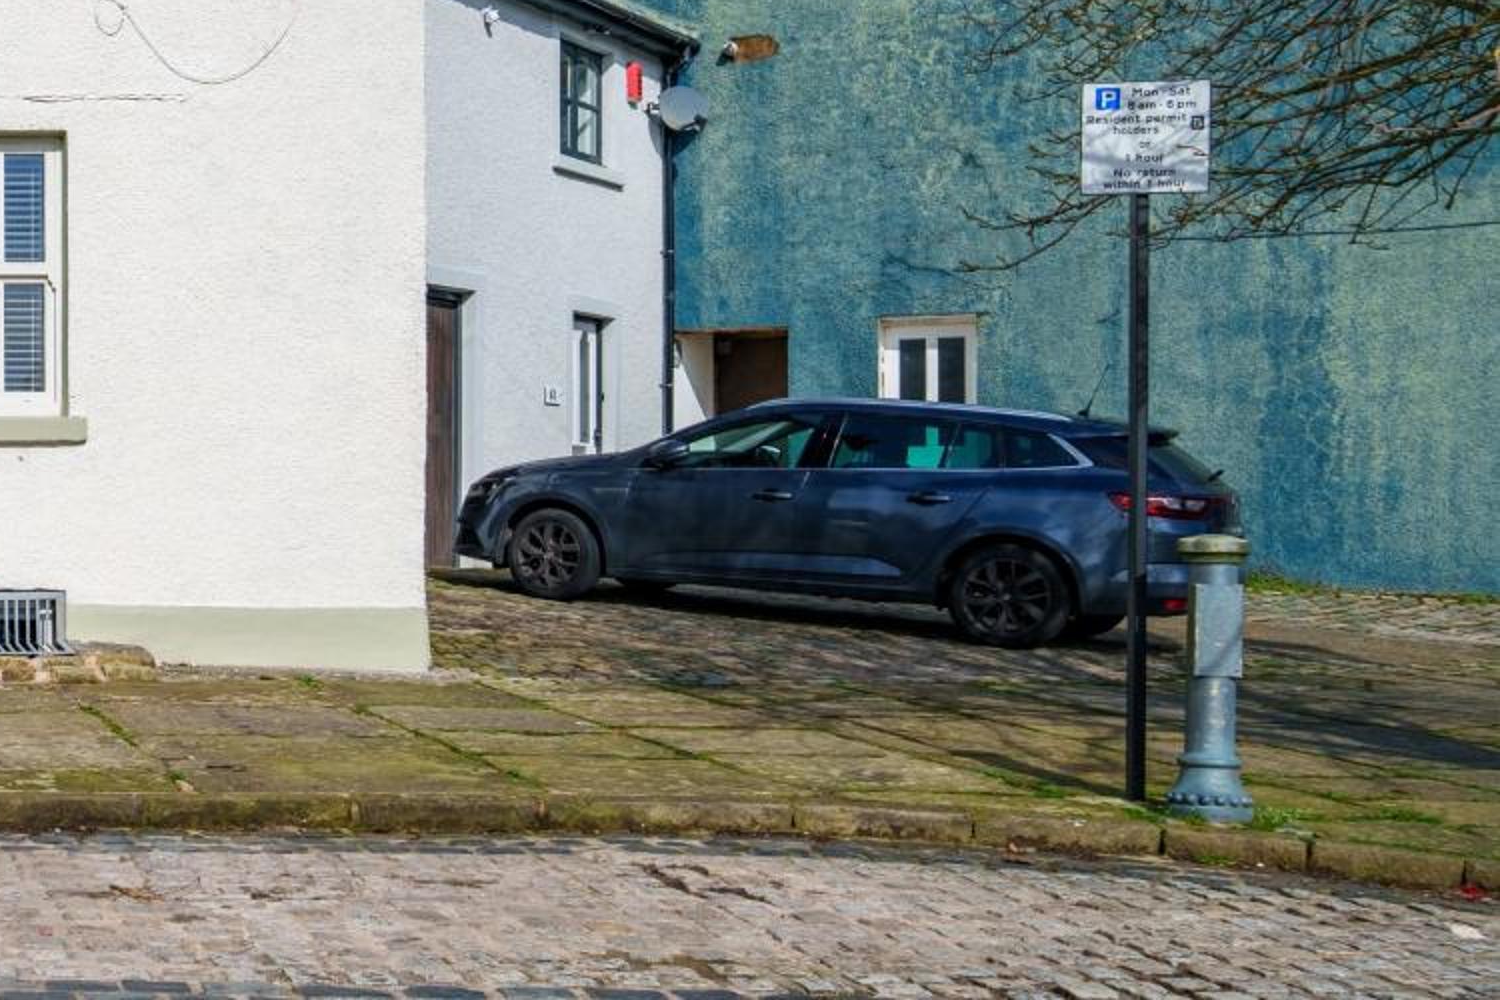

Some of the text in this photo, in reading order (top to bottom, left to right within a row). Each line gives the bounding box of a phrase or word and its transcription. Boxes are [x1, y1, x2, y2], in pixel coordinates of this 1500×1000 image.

[1131, 87, 1159, 97] Mon
[1169, 87, 1191, 97] Sat
[1101, 90, 1117, 108] P
[1086, 114, 1140, 124] Resident
[1145, 112, 1187, 124] permit
[1113, 125, 1159, 135] holders
[1135, 153, 1164, 163] hour
[1113, 168, 1177, 178] No return
[1103, 179, 1141, 190] within
